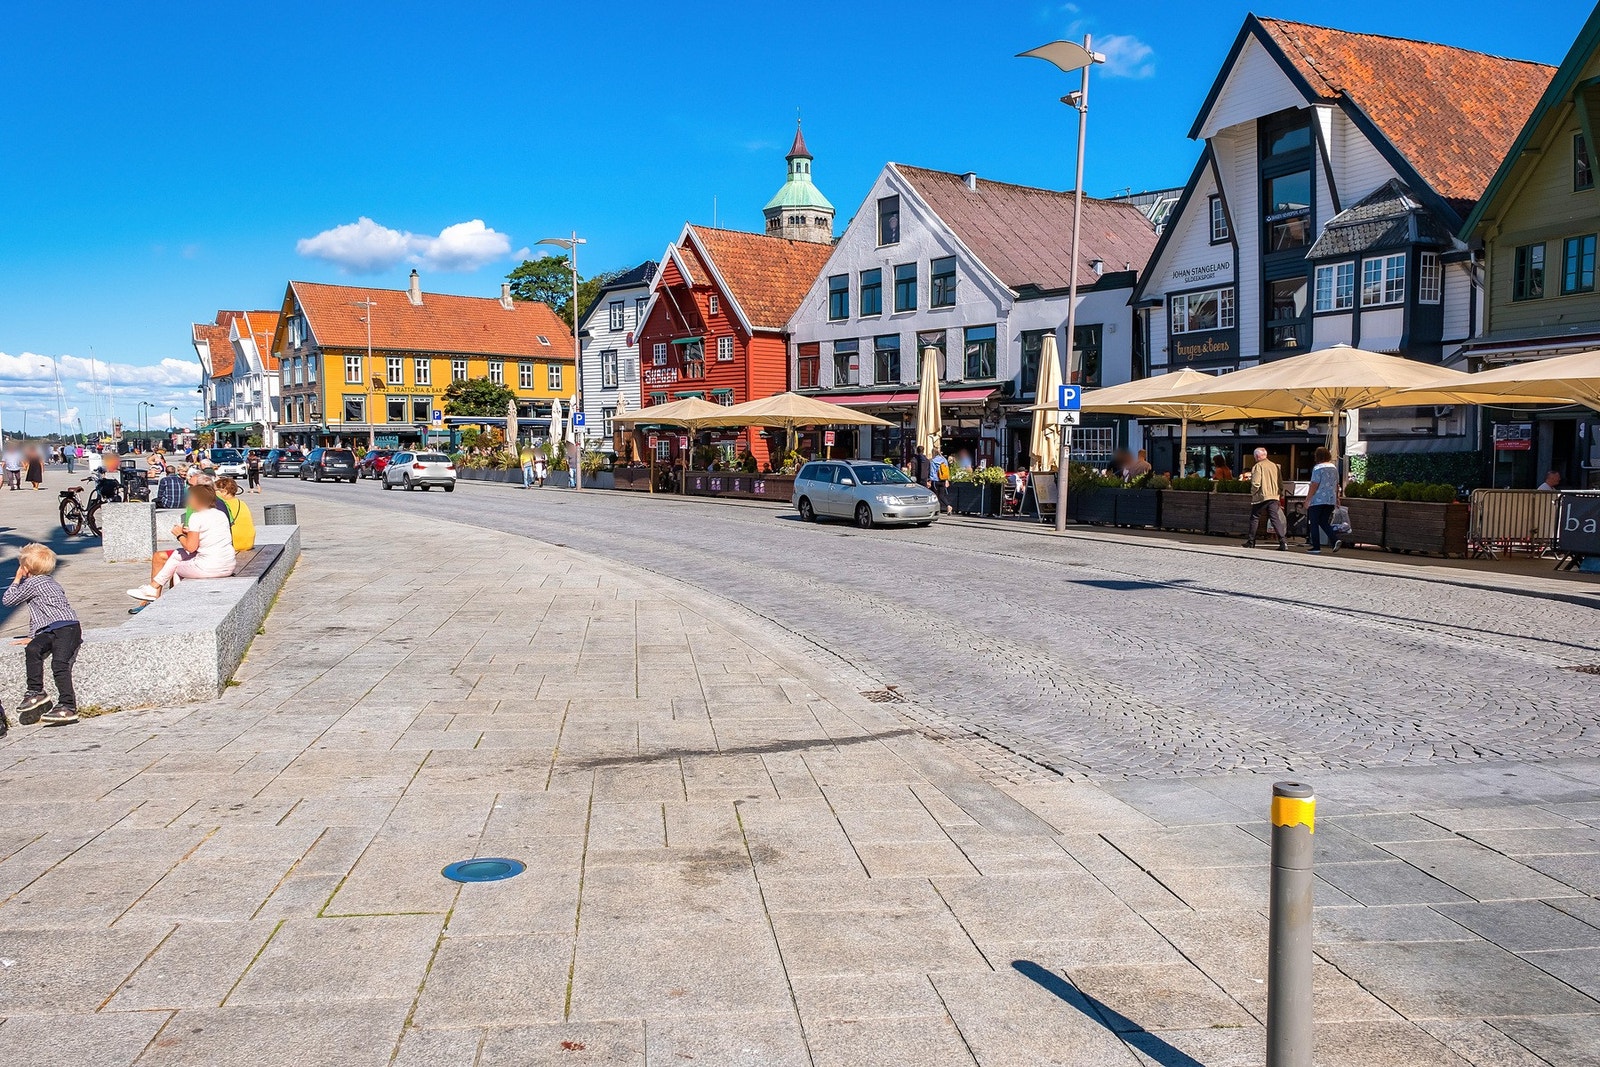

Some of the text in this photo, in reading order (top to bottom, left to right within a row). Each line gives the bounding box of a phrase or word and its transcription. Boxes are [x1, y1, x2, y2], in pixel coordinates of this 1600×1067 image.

[1172, 261, 1230, 279] JOHAN STANGELAND
[1174, 341, 1202, 360] burger
[1206, 337, 1230, 352] beers
[1064, 388, 1076, 407] P
[576, 414, 583, 425] P
